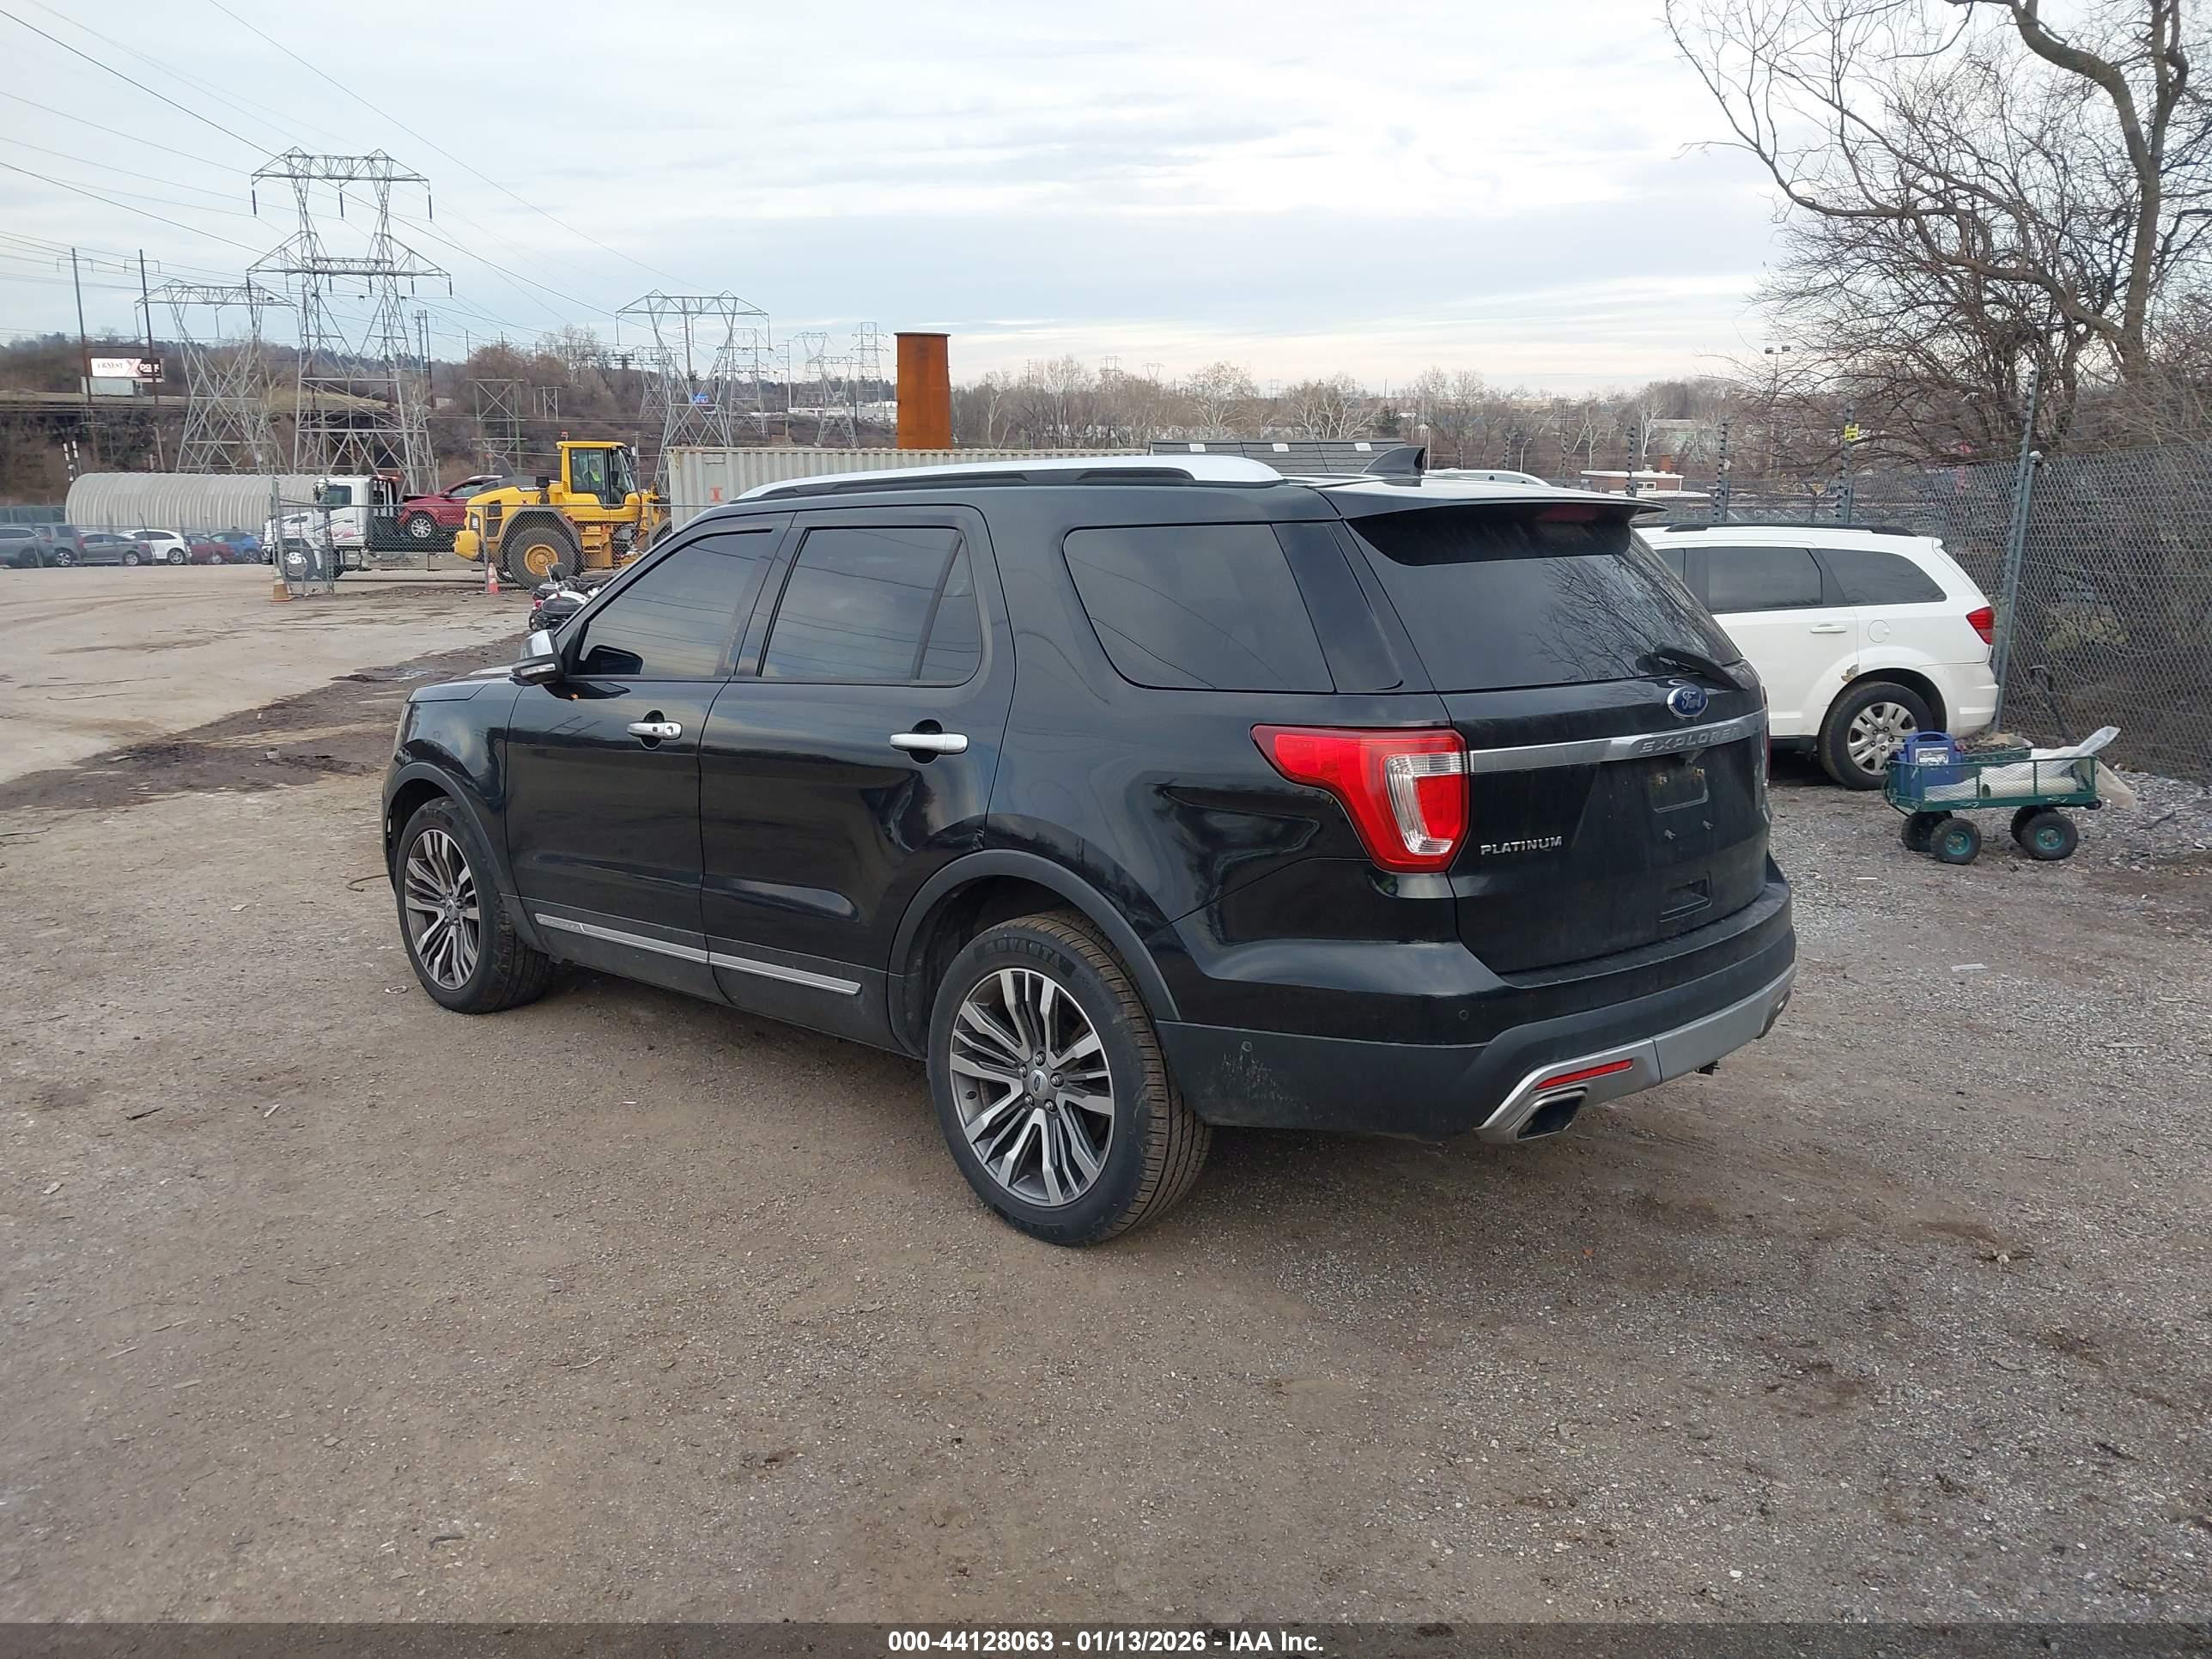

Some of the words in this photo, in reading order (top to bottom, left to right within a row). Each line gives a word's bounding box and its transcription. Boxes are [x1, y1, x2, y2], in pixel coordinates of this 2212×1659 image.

[1681, 690, 1703, 709] Ford
[1639, 726, 1741, 754] EXPLORER
[1480, 836, 1563, 855] PLATINUM
